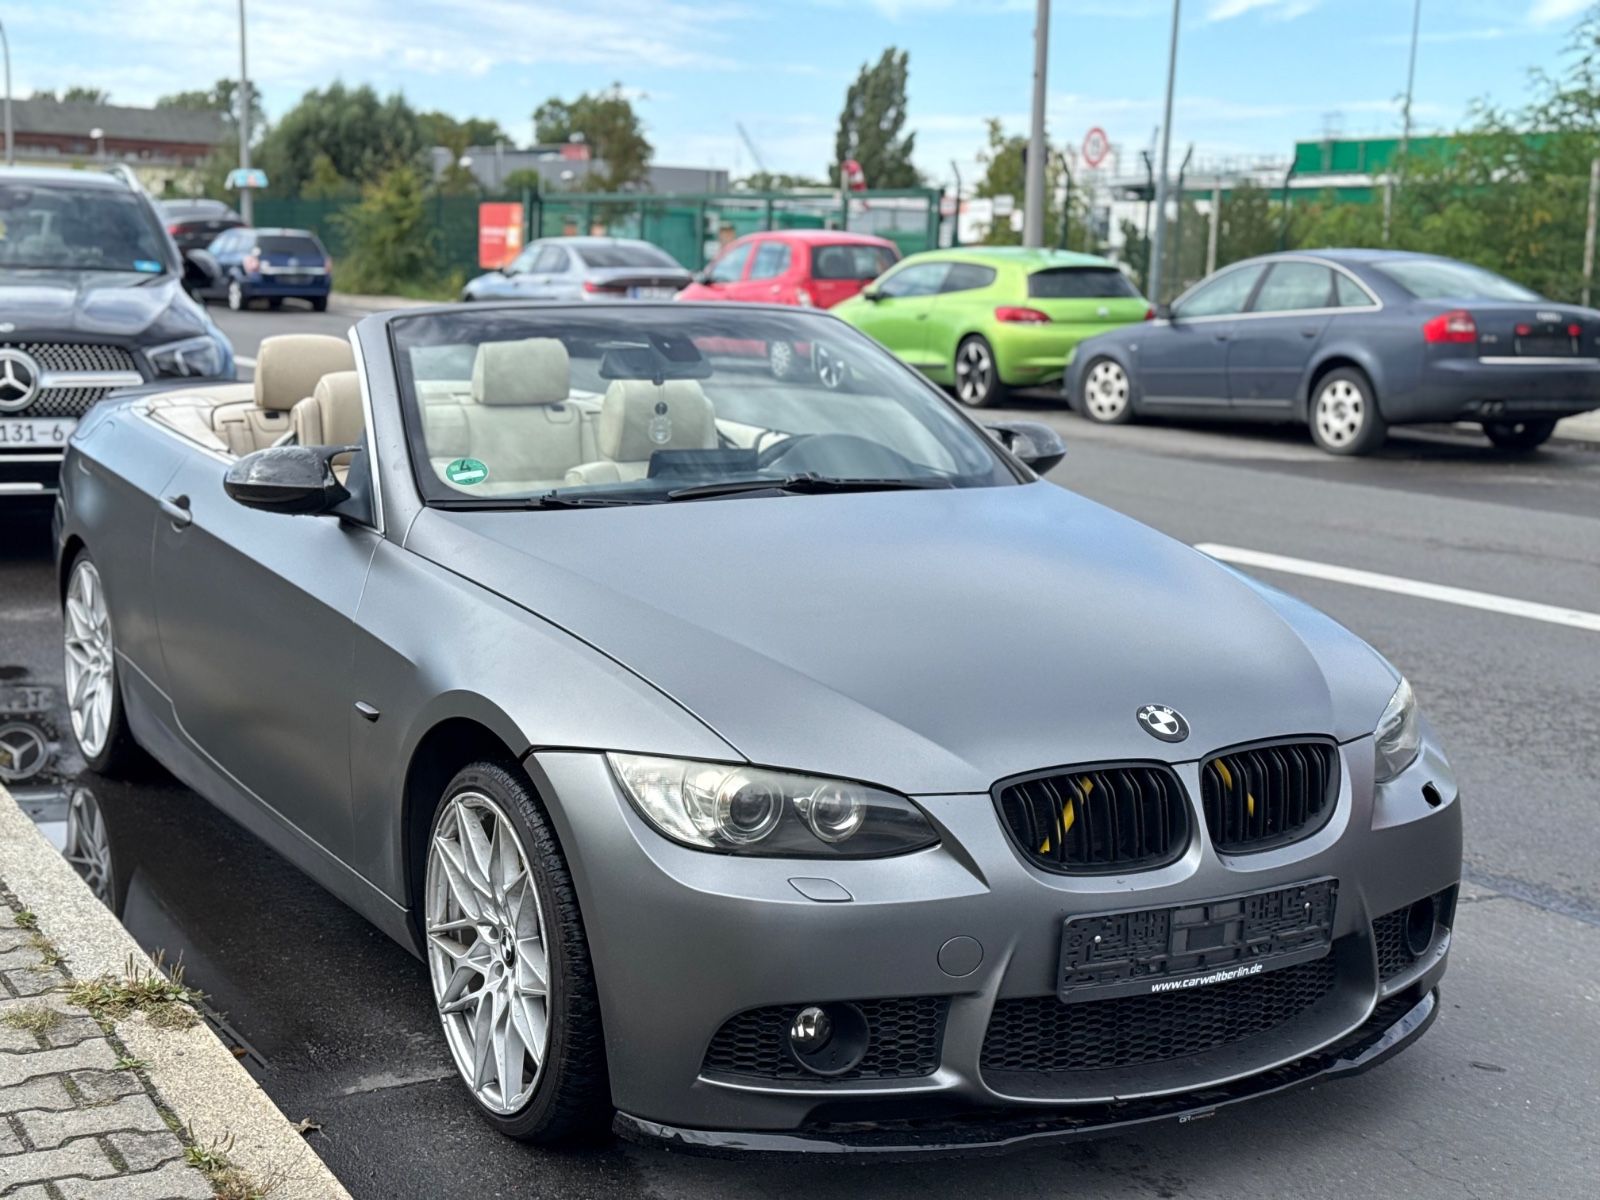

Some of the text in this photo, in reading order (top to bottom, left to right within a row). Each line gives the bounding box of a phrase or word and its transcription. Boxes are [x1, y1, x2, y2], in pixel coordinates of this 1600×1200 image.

[460, 459, 471, 471] 4
[1139, 705, 1174, 720] BMW
[1151, 964, 1263, 992] www.carweltberlin.de
